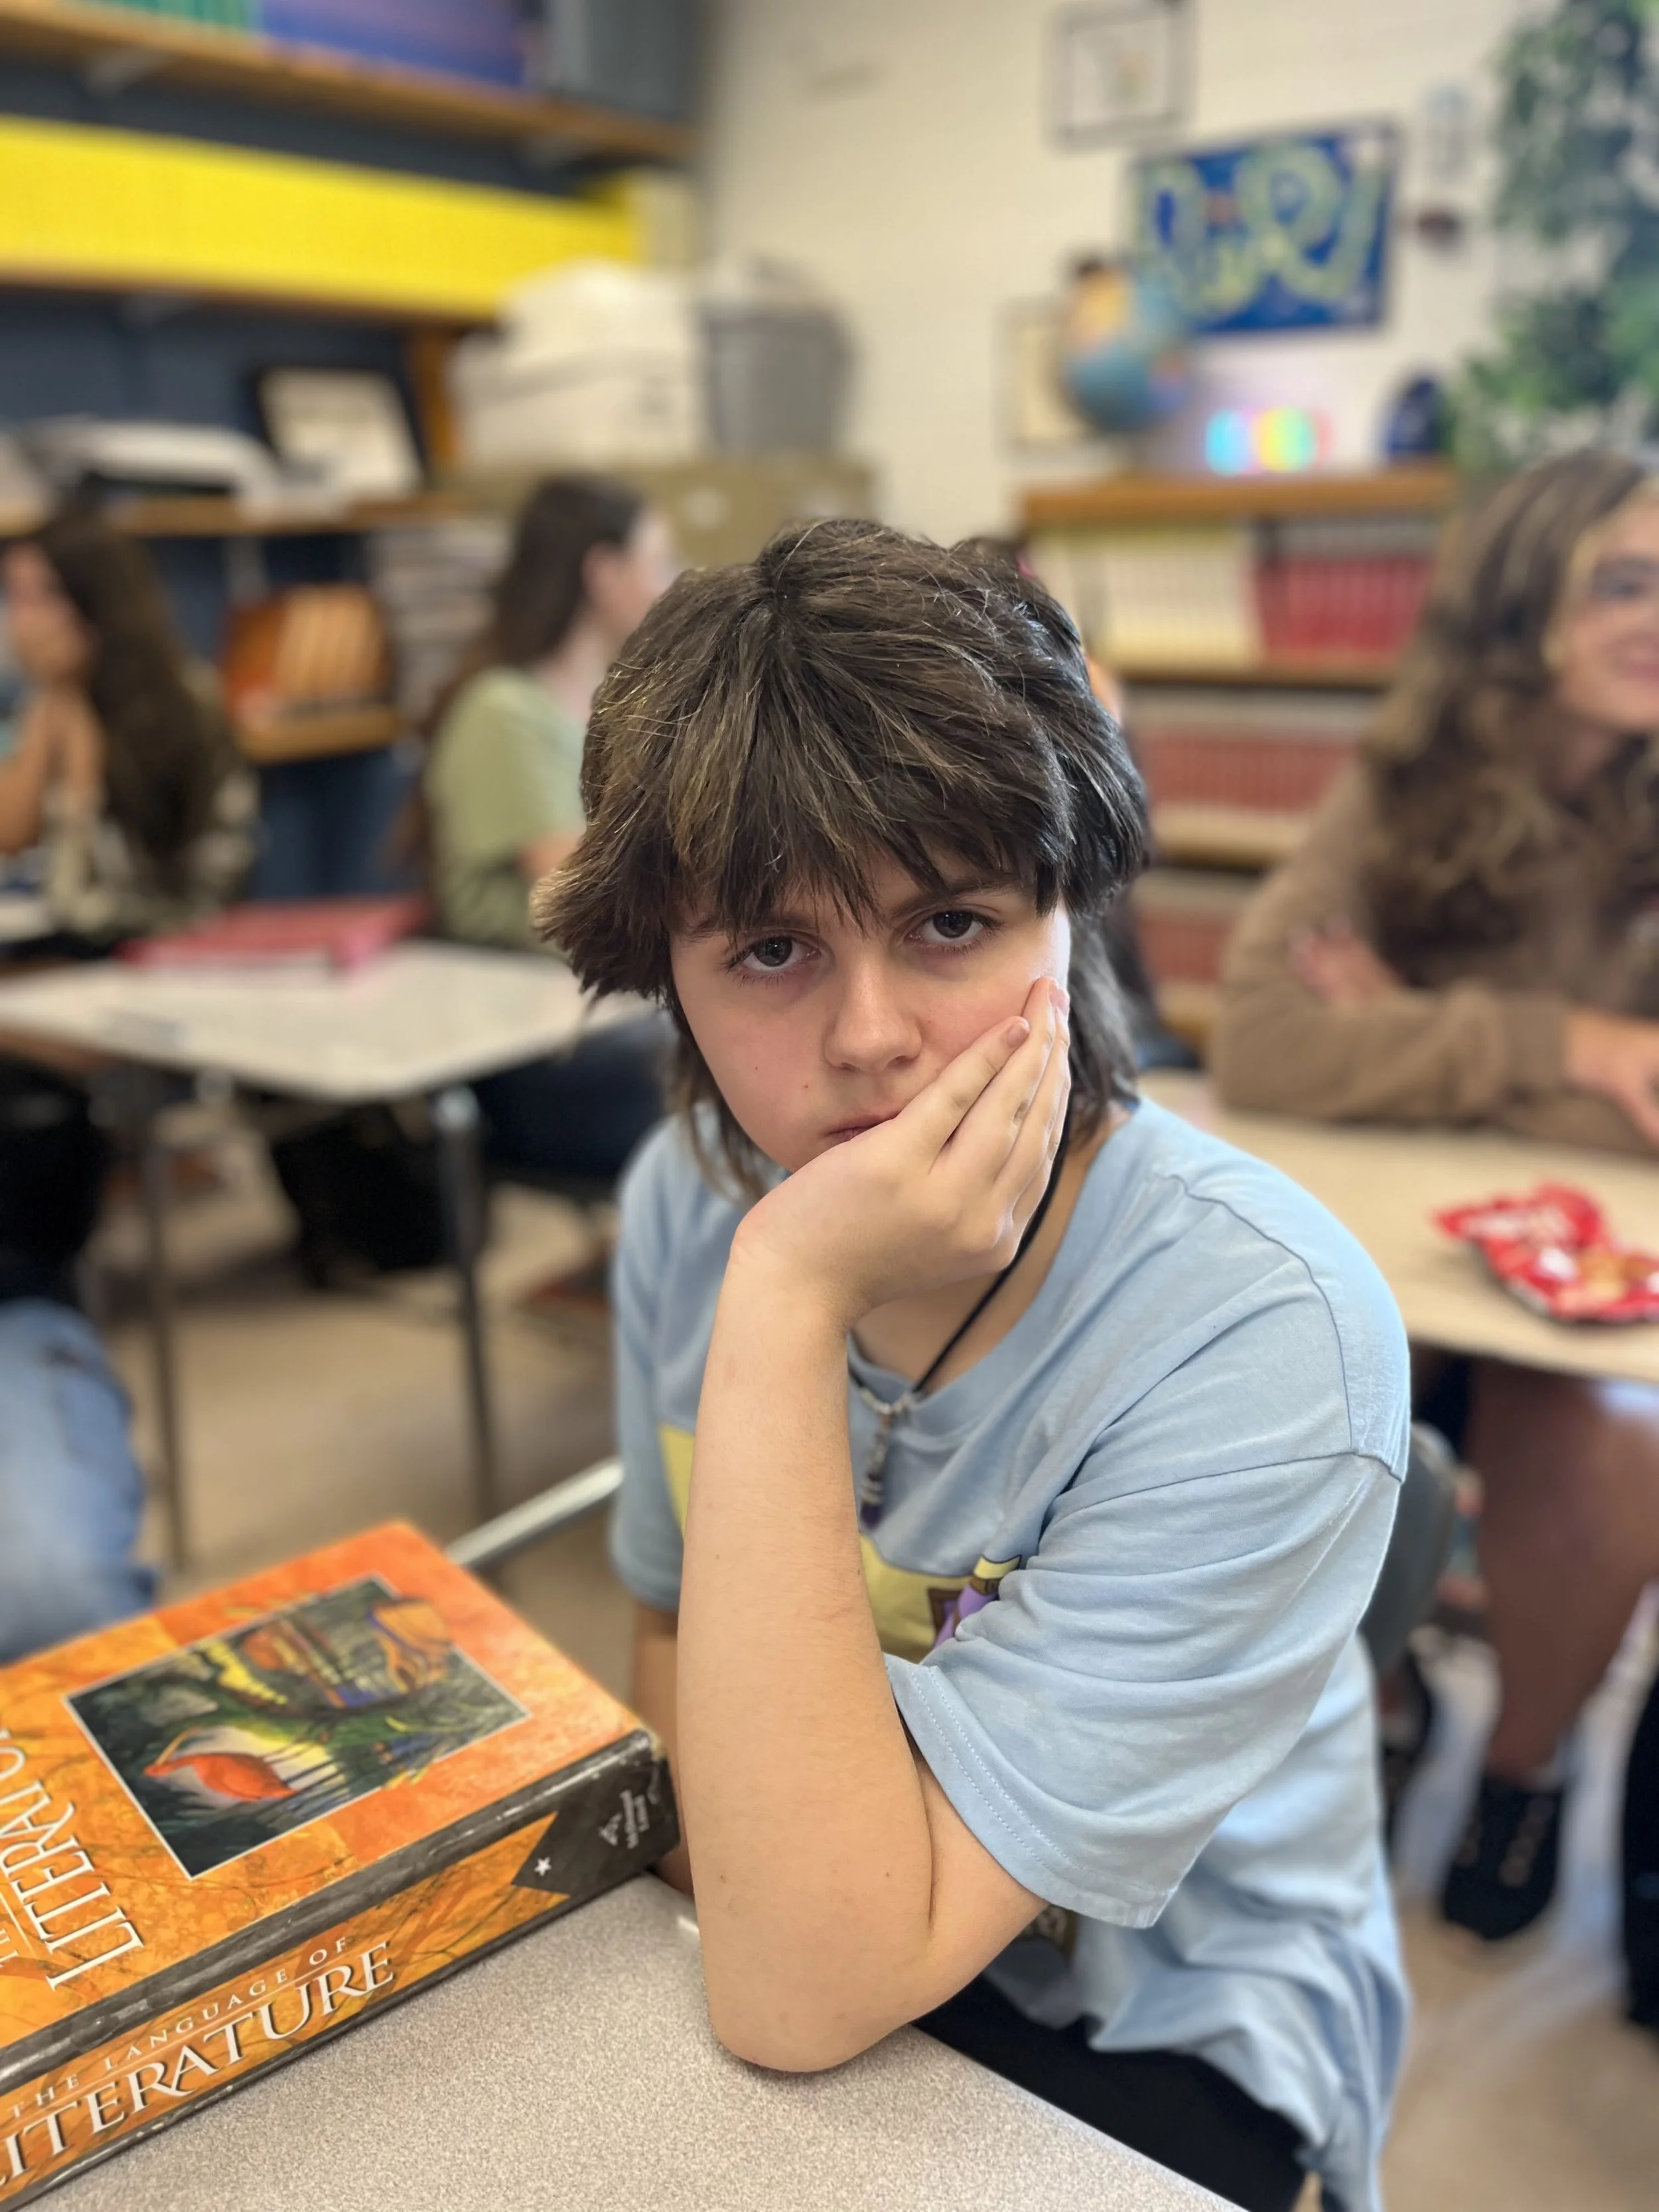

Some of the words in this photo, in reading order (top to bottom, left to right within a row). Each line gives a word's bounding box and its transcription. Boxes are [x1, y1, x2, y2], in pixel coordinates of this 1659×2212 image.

[0, 1941, 395, 2185] ITERATURE
[7, 2073, 80, 2118] THE
[104, 1968, 289, 2071] LANGUAGE
[308, 1937, 347, 1966] OF
